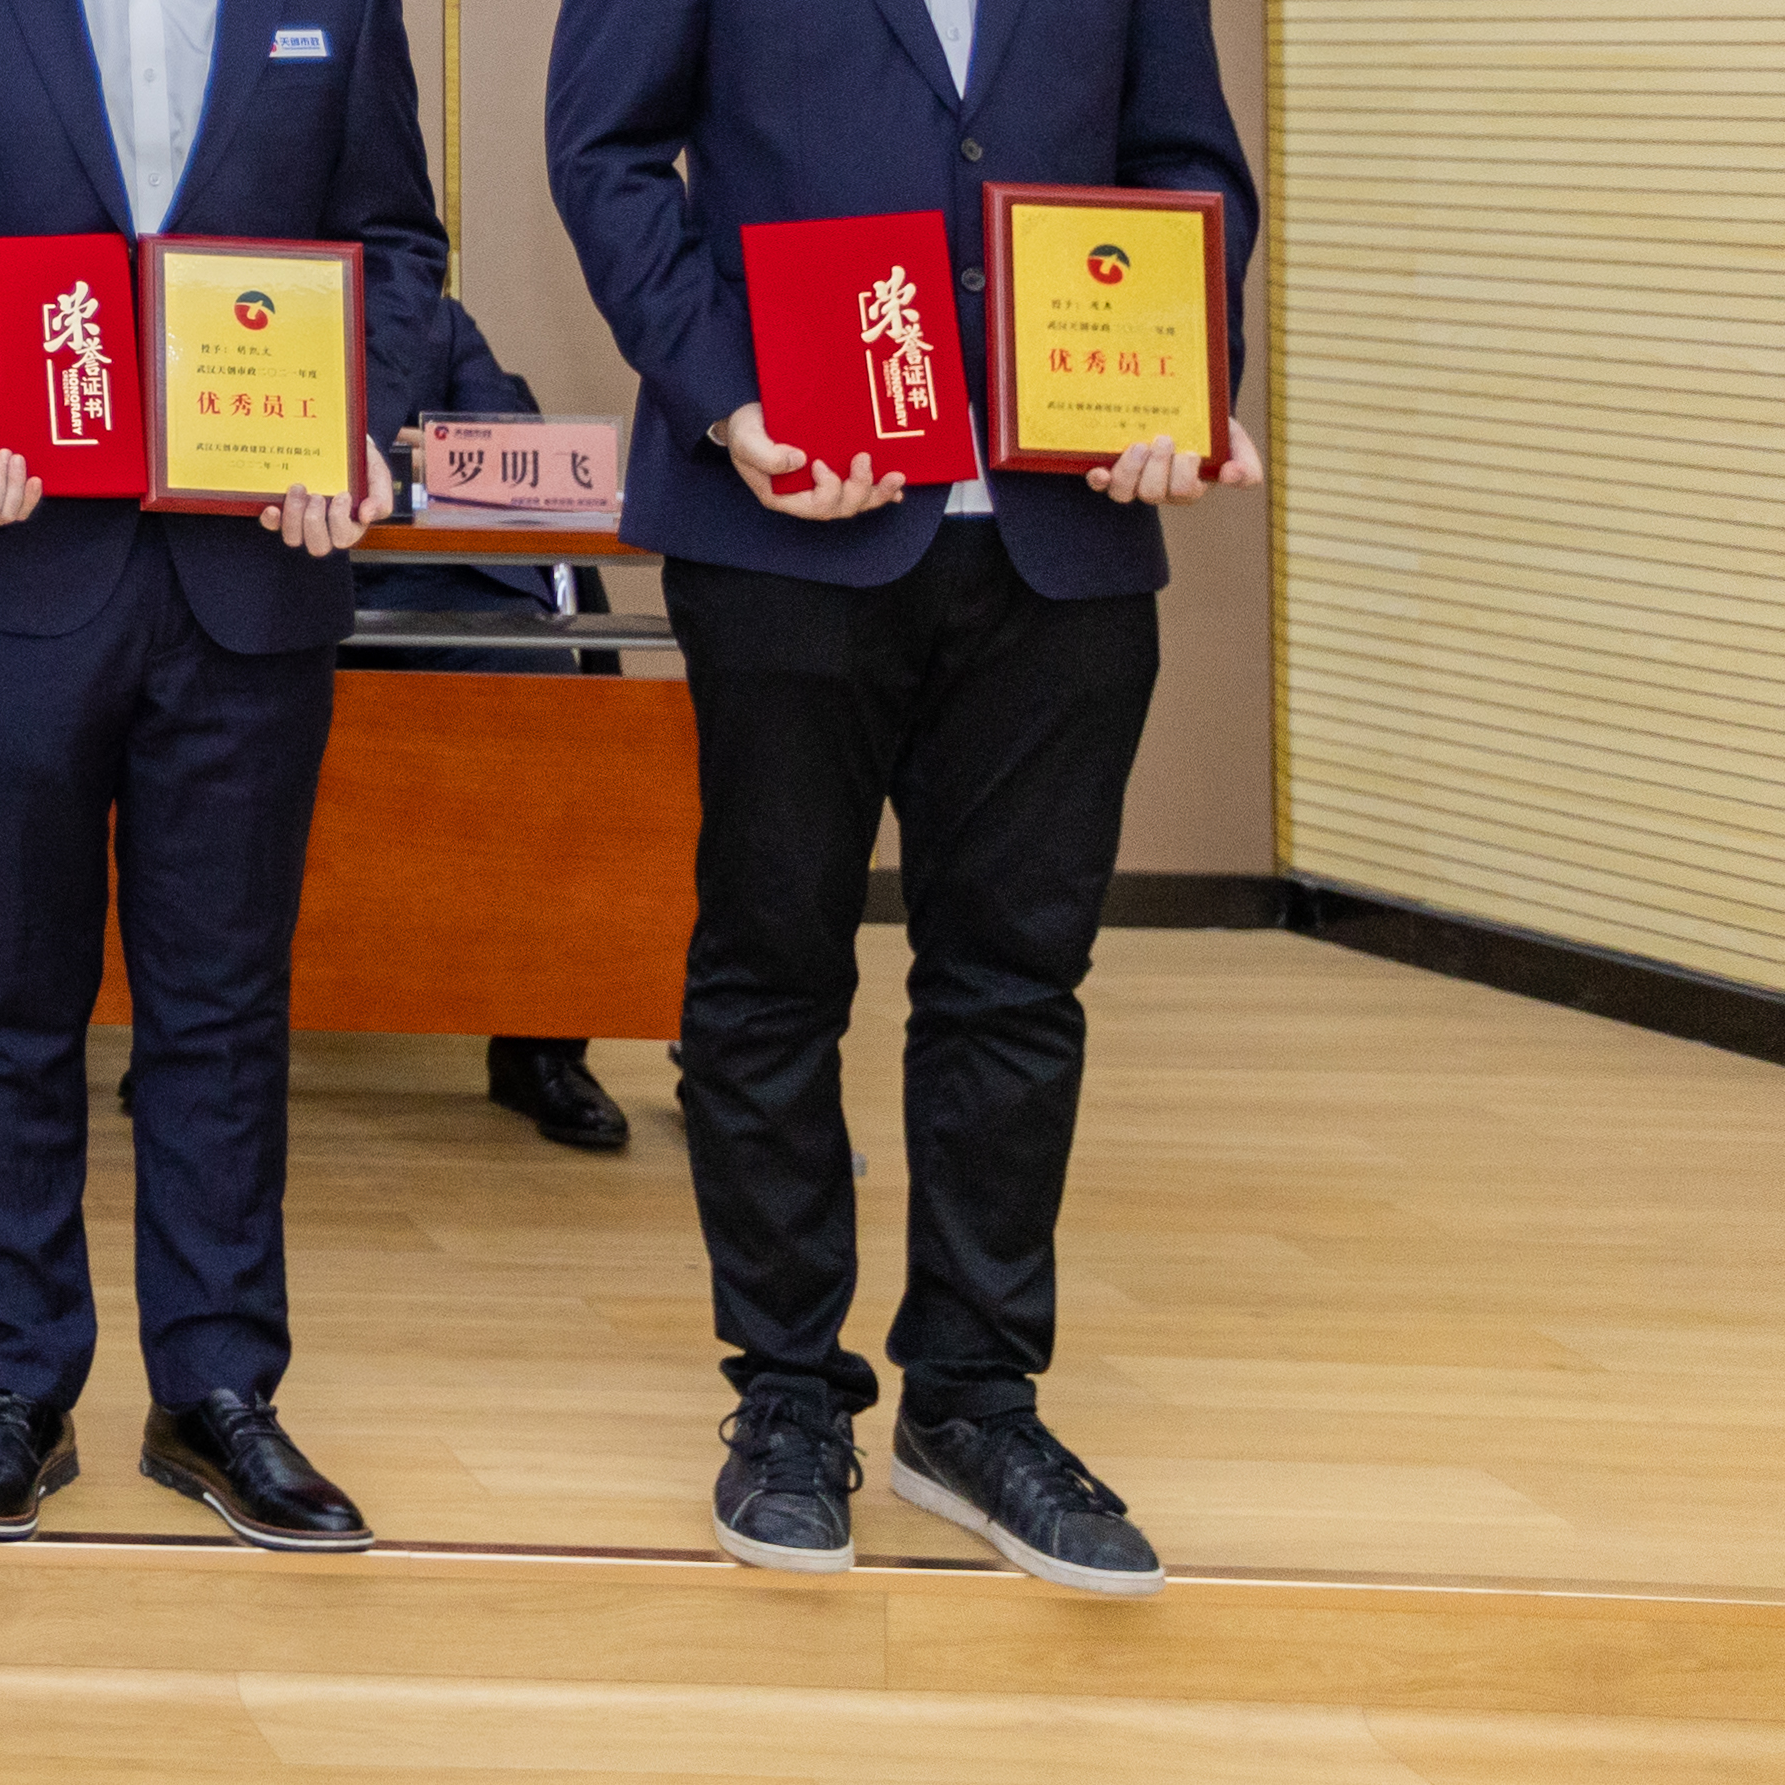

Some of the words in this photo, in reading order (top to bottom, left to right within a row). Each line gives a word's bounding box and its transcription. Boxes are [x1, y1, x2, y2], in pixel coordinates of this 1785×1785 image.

[43, 280, 112, 419] 荣誉证书
[861, 265, 934, 410] 荣誉证书
[1049, 348, 1176, 377] 优秀员工
[68, 368, 83, 436] HONORARY
[197, 391, 317, 419] 优秀员工
[448, 449, 594, 489] 罗明飞
